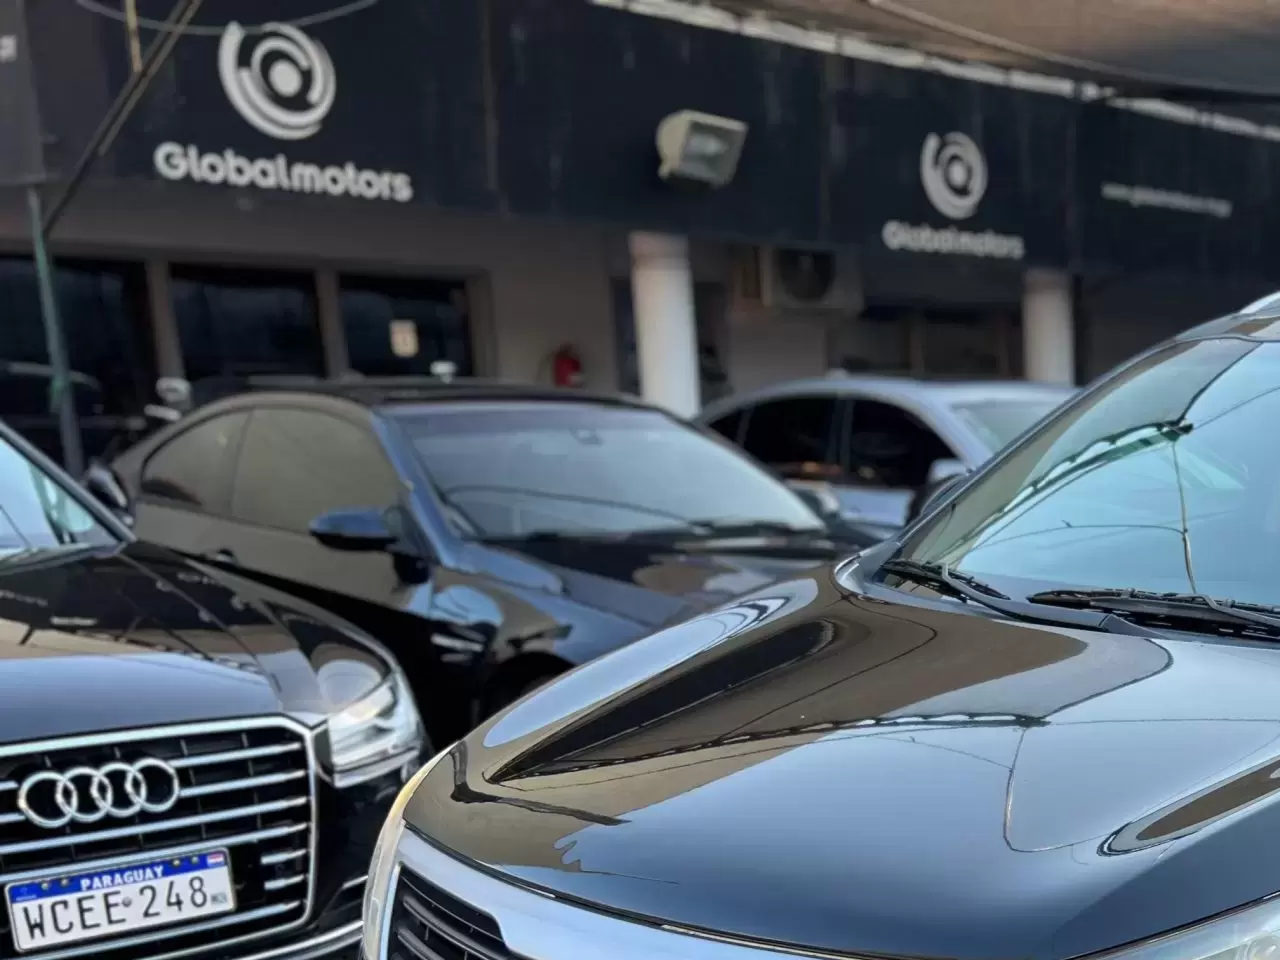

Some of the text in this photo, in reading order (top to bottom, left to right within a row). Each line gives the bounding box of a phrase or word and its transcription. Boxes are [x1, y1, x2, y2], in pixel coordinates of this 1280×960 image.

[154, 142, 413, 202] Globalmotors
[22, 875, 209, 940] WCEE 248
[79, 865, 165, 892] PARAGUAY
